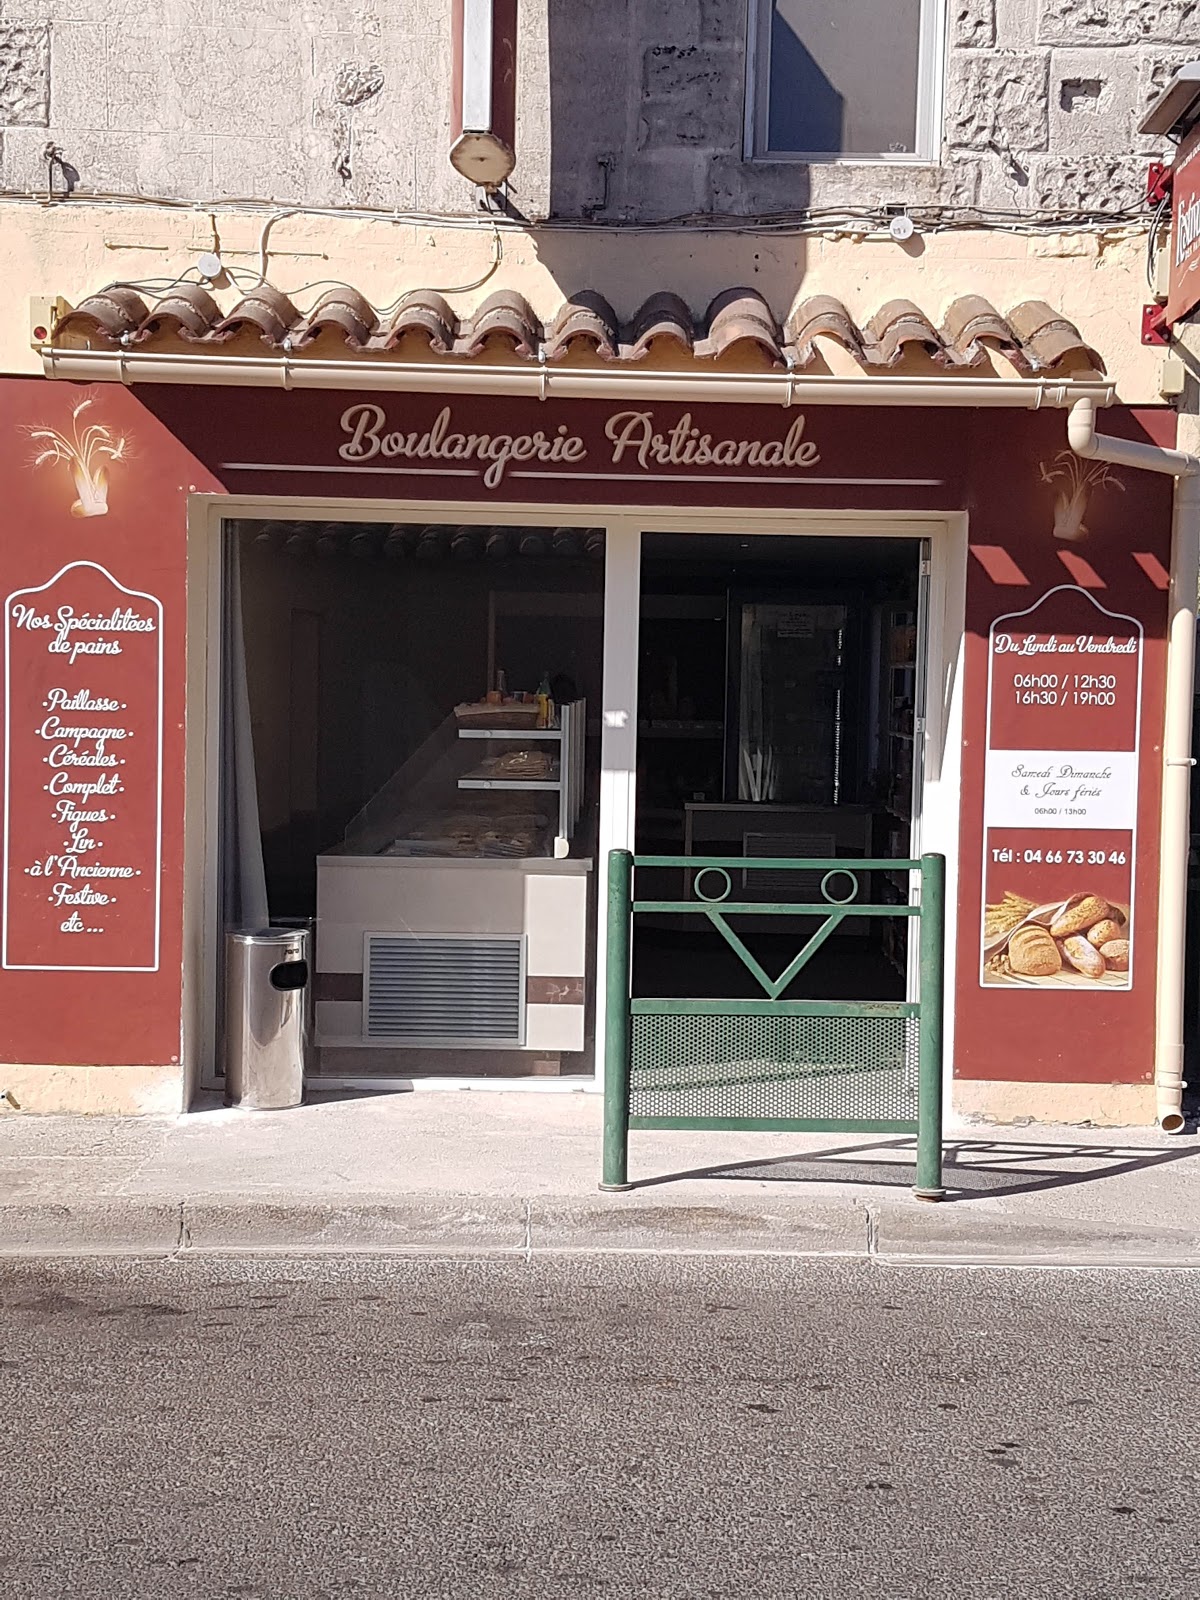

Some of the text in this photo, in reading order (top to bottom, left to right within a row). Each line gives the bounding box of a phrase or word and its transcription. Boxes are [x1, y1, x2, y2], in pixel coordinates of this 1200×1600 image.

[338, 403, 822, 489] Boulangerie Artisanale
[12, 604, 52, 630] Nos
[48, 632, 123, 664] de pains
[995, 634, 1138, 656] Du Lundi au Vendredi
[1013, 674, 1116, 689] 06h00 / 12h30
[1015, 691, 1116, 706] 16h30 / 19h00
[1011, 764, 1112, 779] Samedi Dimanche
[1020, 782, 1102, 801] & Jours fériés
[992, 848, 1013, 862] Tél
[1024, 849, 1042, 862] 04
[1045, 850, 1063, 863] 66
[1067, 850, 1084, 864] 73
[1087, 851, 1105, 864] 30
[1108, 851, 1126, 865] 46
